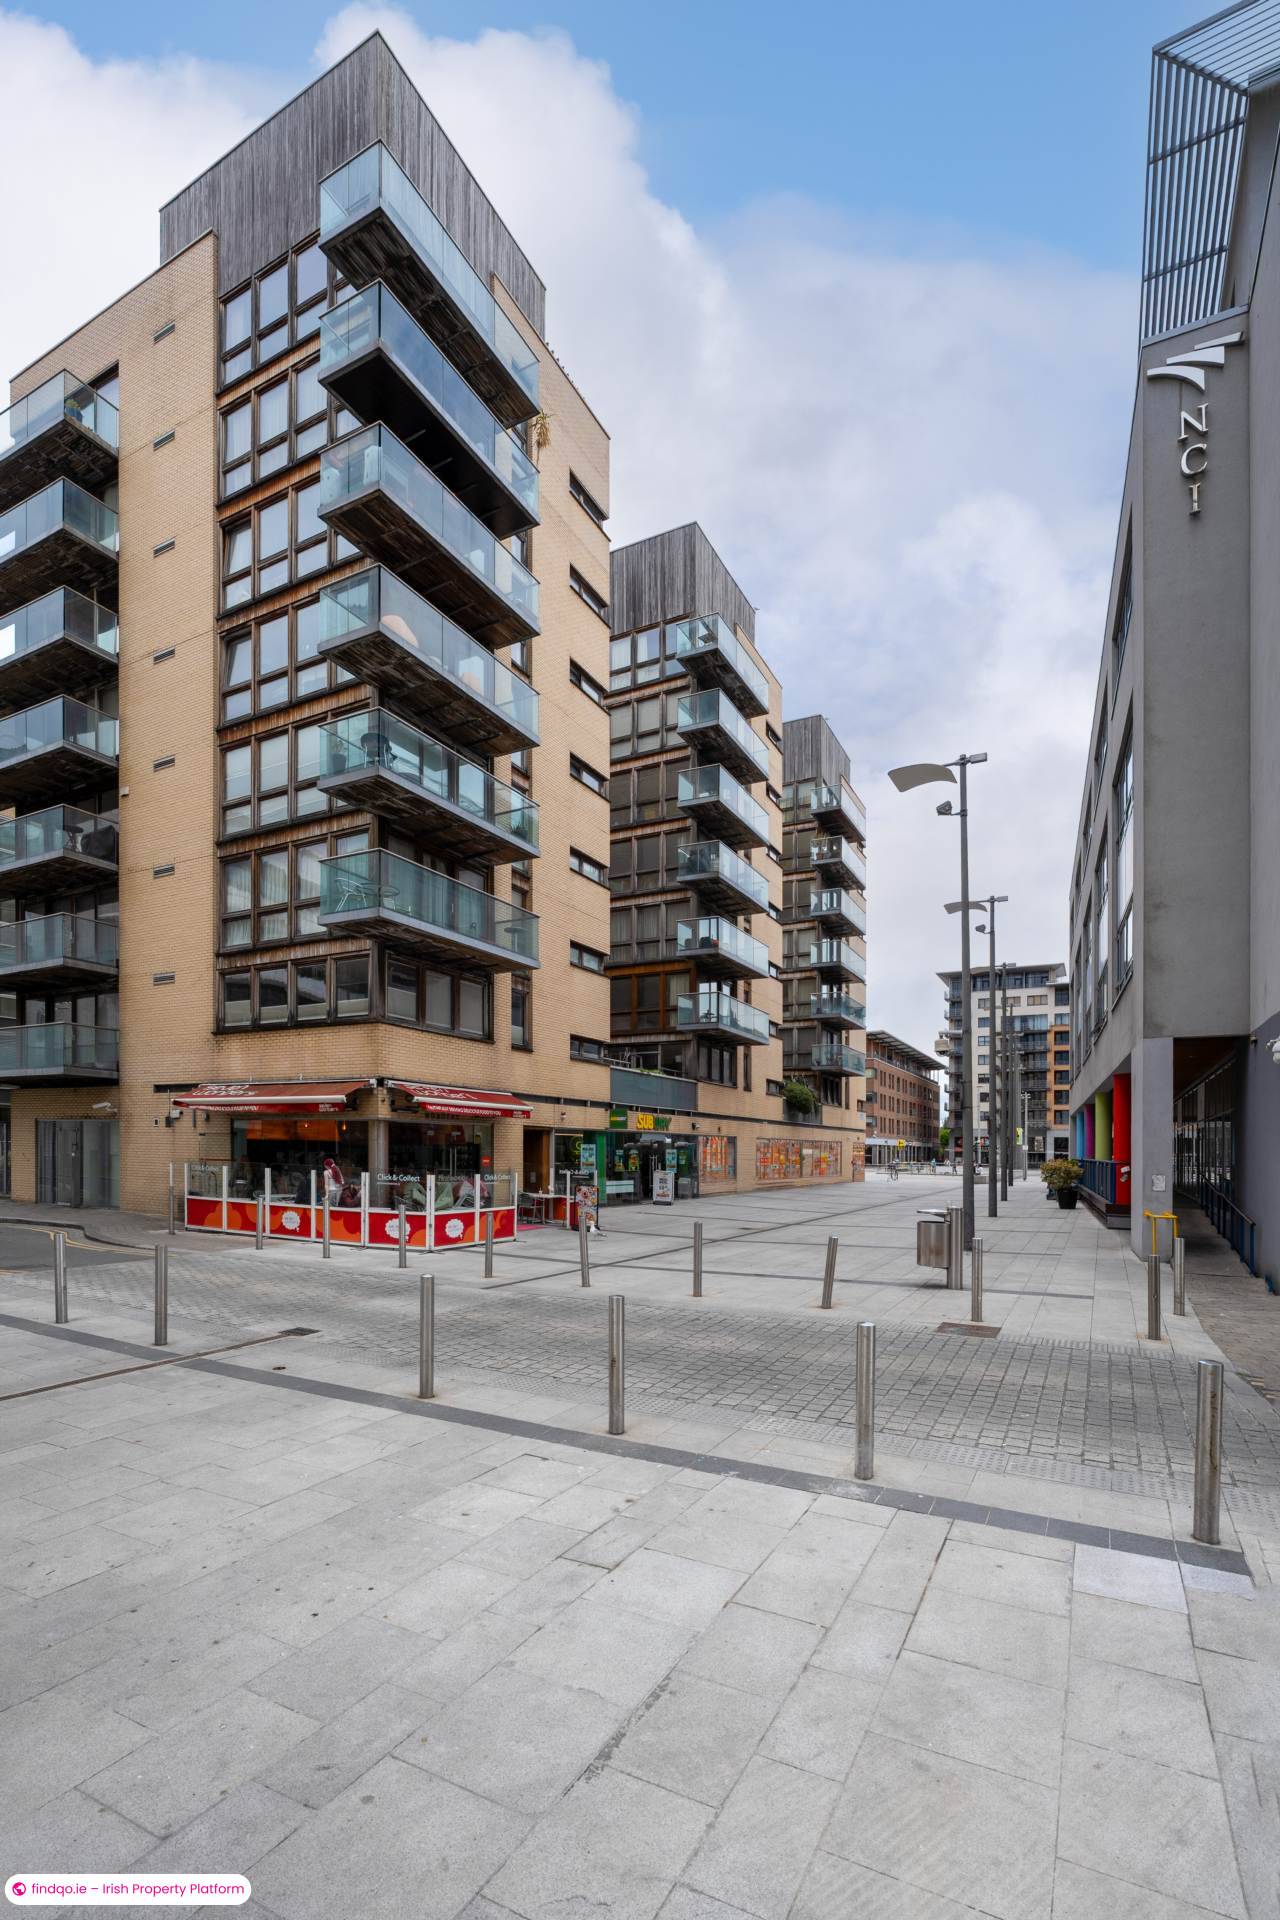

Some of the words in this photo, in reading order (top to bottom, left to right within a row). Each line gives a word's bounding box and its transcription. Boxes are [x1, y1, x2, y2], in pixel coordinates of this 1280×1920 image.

[1178, 403, 1208, 514] NCI
[636, 1113, 672, 1131] SUBWAY
[378, 1173, 392, 1181] Click
[399, 1174, 420, 1182] Collect
